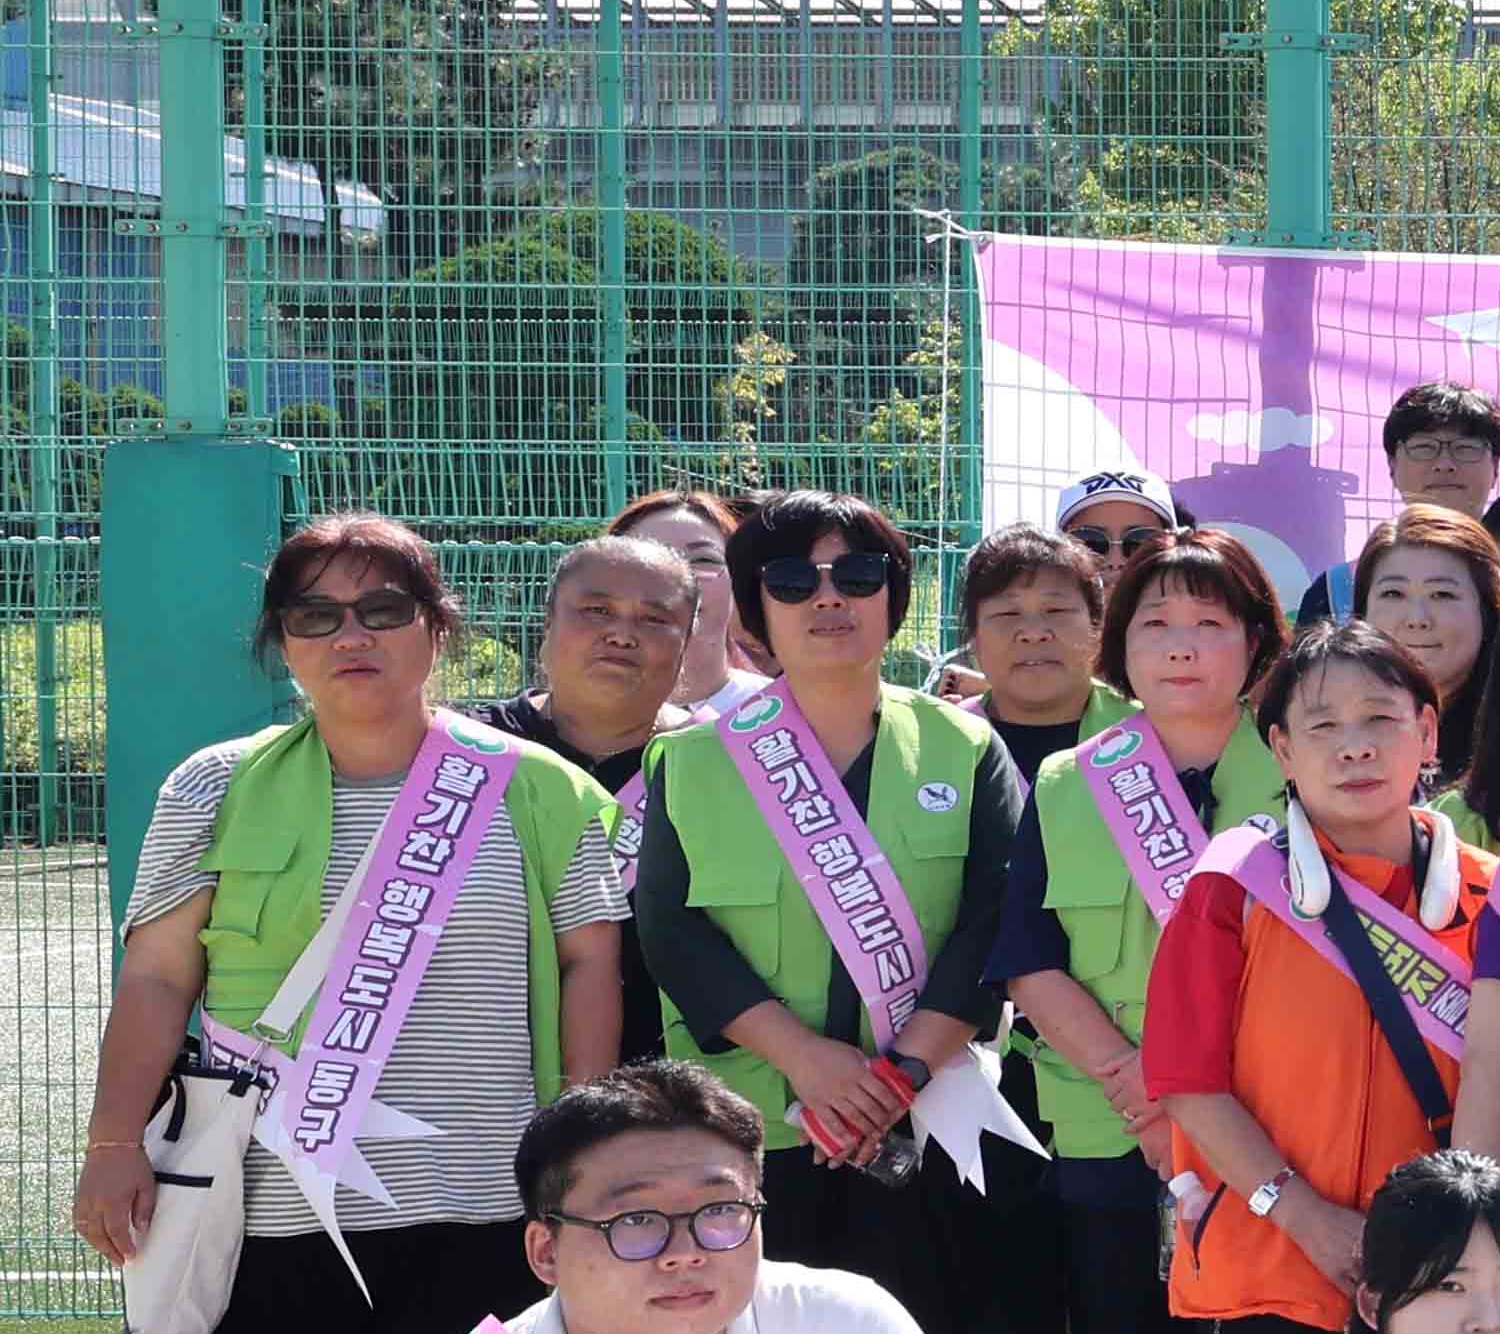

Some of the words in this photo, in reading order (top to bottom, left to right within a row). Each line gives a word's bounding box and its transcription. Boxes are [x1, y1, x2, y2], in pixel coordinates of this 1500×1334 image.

[397, 753, 489, 875] 활기찬
[750, 729, 841, 836] 활기찬
[808, 834, 914, 993] 행복도시
[1108, 762, 1195, 871] 활기찬
[322, 878, 433, 1054] 행복도시
[295, 1059, 358, 1153] 동구
